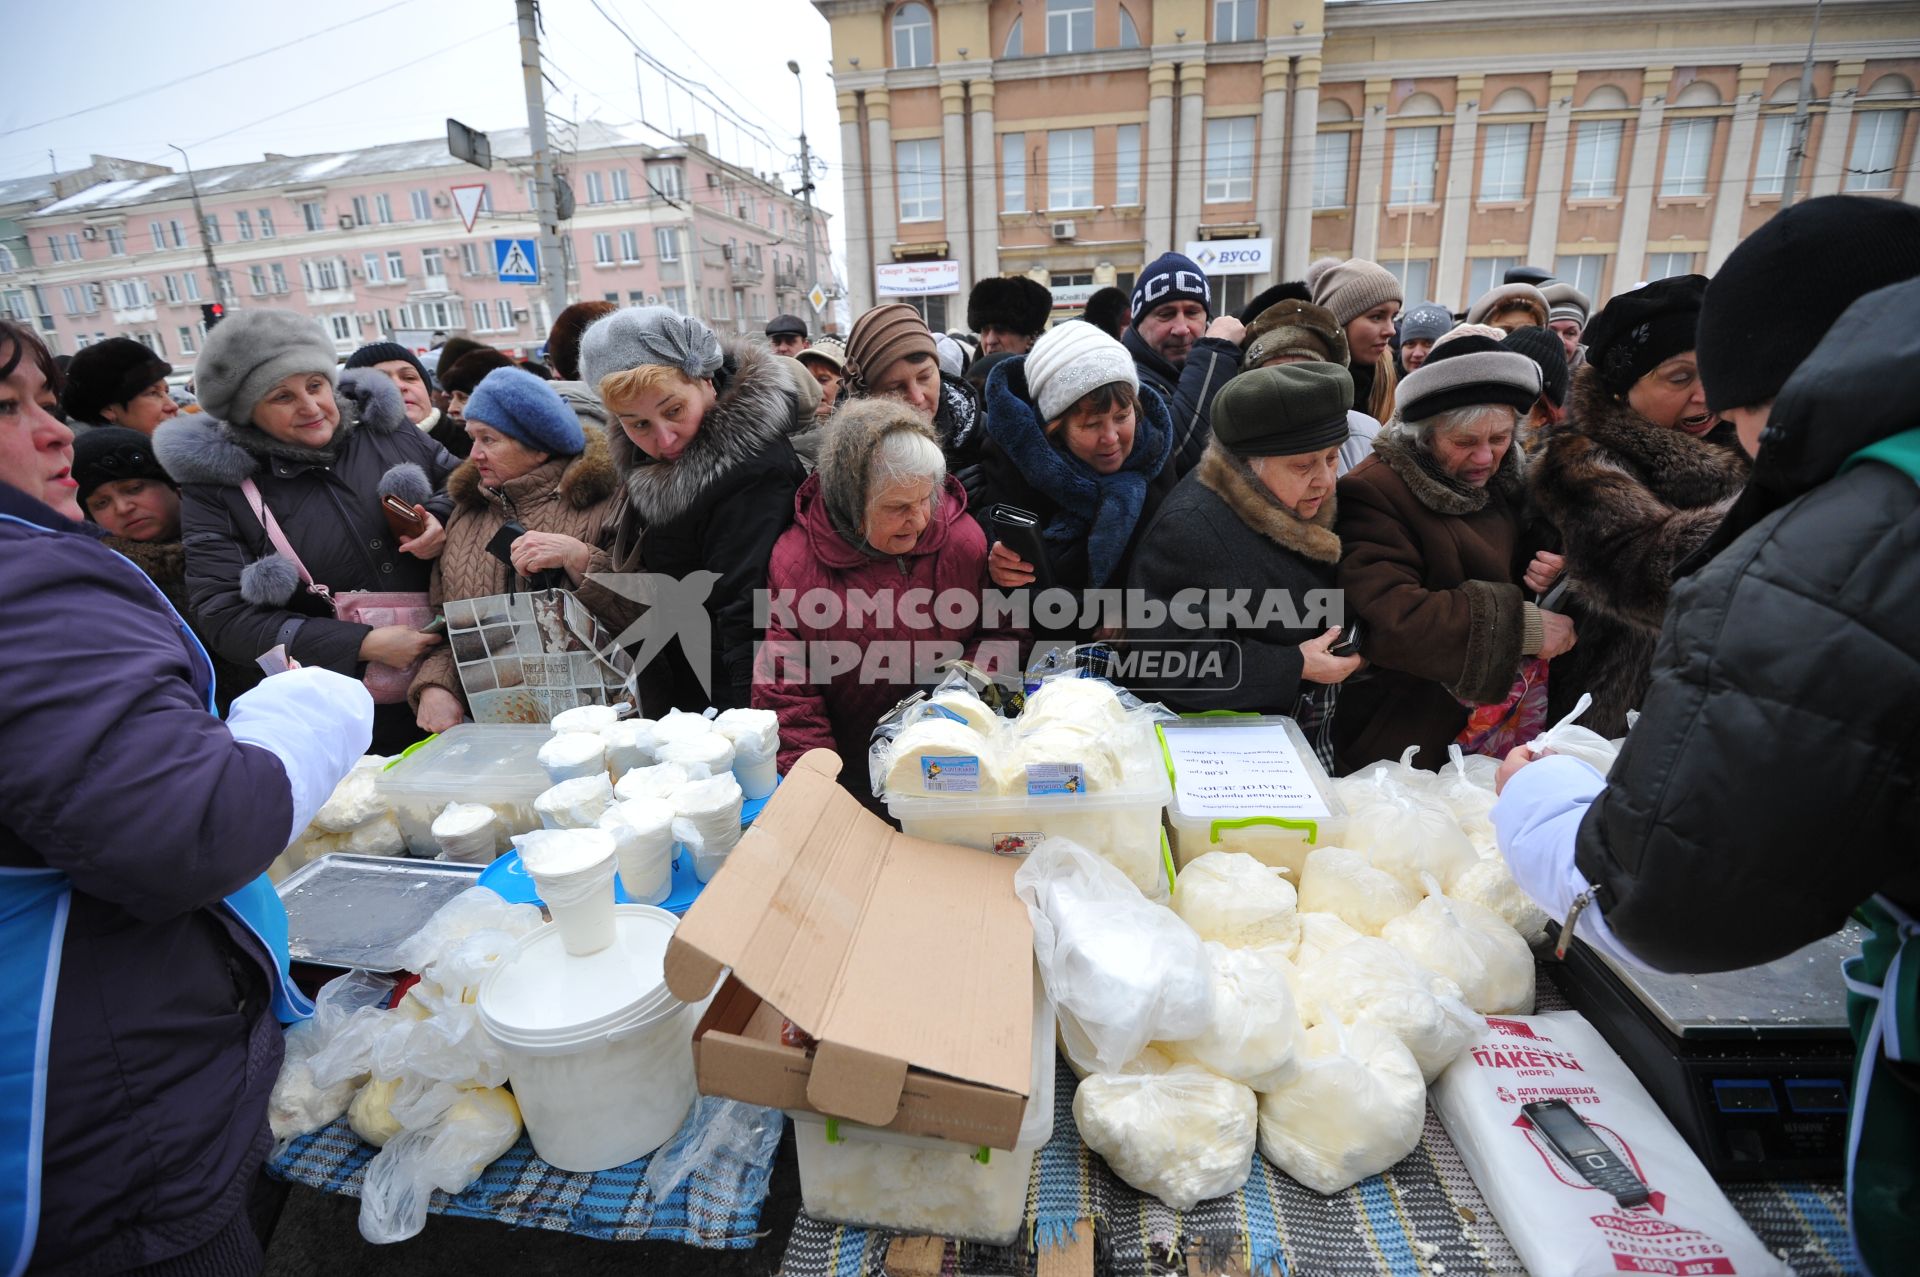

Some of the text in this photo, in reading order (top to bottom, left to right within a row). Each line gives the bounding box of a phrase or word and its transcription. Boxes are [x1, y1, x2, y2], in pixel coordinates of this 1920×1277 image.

[1219, 250, 1262, 263] ВУСО
[1470, 1043, 1574, 1059] ФАСОВОЧНЫЕ
[1472, 1051, 1584, 1072] ПАКЕТЫ
[1516, 1069, 1555, 1078] (HDPE)
[1517, 1087, 1597, 1097] ДЛЯ ПИЩЕВЫХ
[1606, 1239, 1724, 1257] КОЛИЧЕСТВО
[1632, 1257, 1679, 1275] 1000
